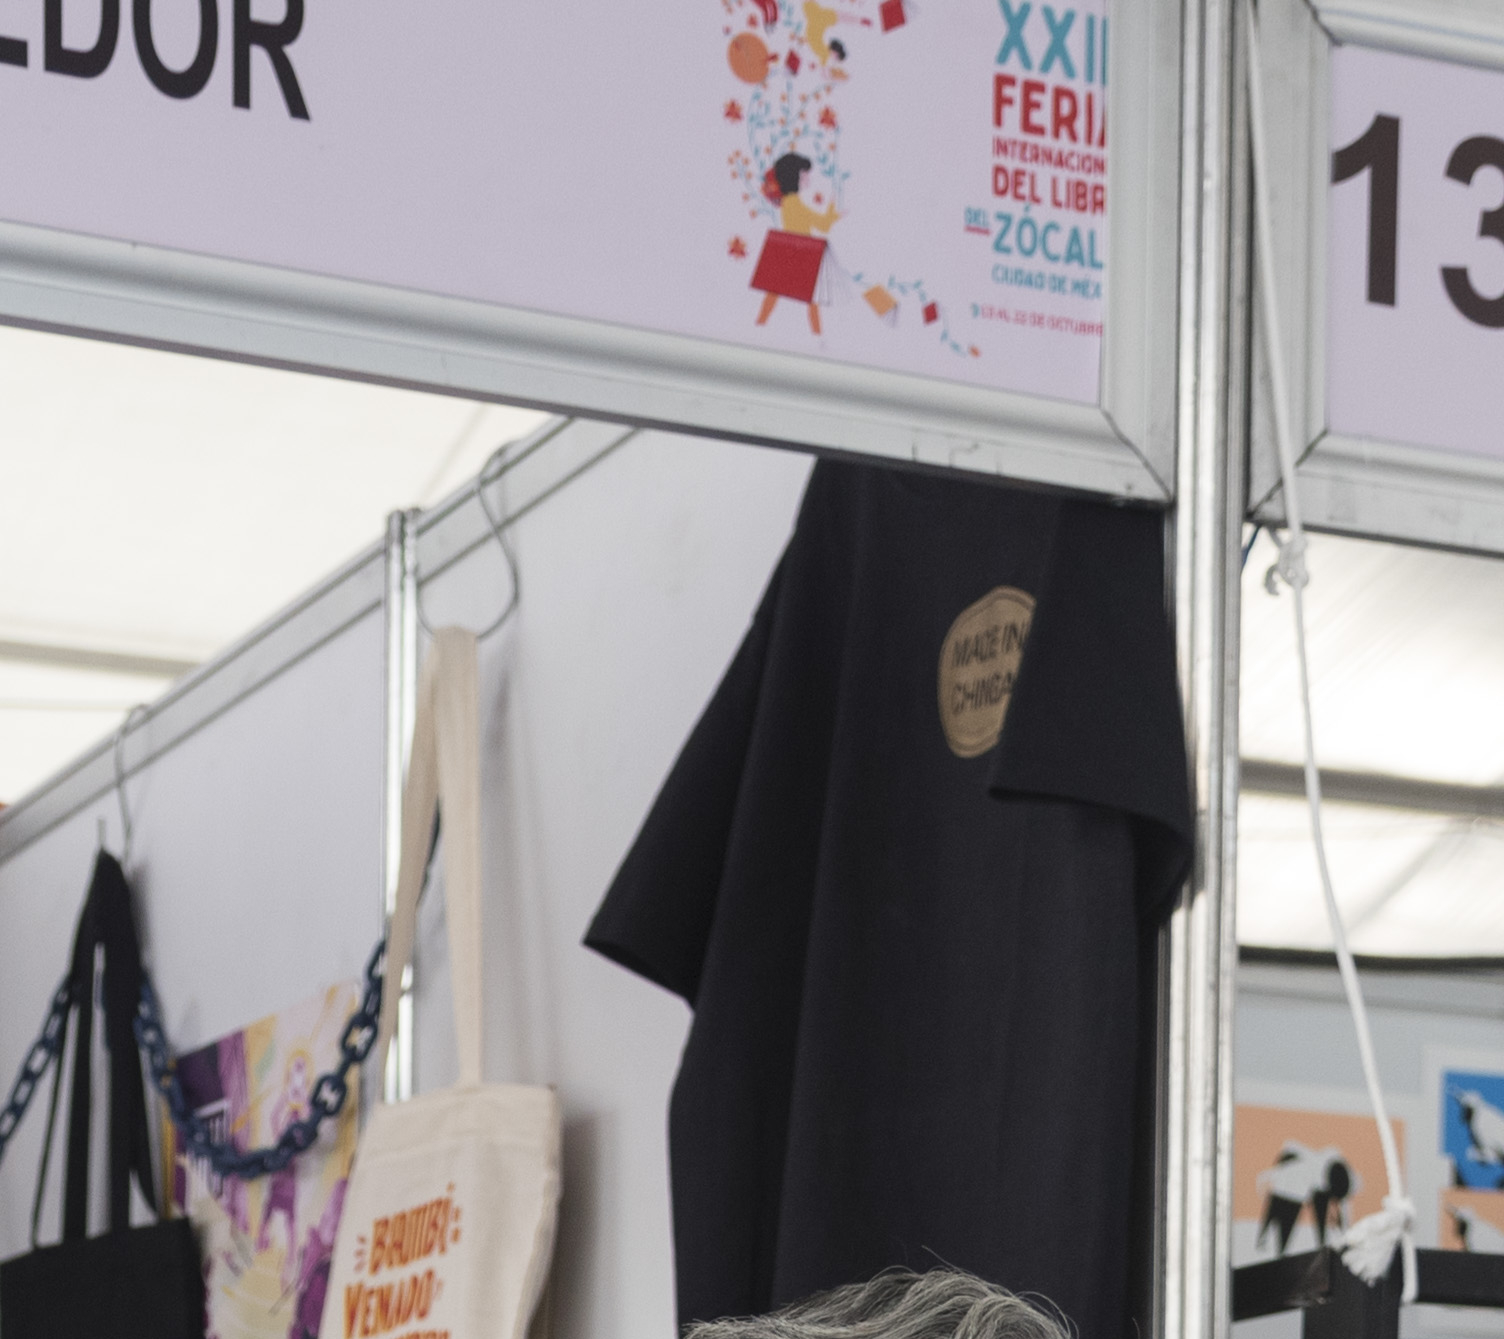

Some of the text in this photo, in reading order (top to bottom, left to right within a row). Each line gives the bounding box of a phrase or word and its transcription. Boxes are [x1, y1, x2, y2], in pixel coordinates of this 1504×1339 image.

[992, 164, 1107, 216] DEL LIBR
[992, 202, 1104, 270] ZÓCAL
[992, 264, 1069, 293] CIUDAD DE
[1047, 313, 1103, 337] OCTUBRE
